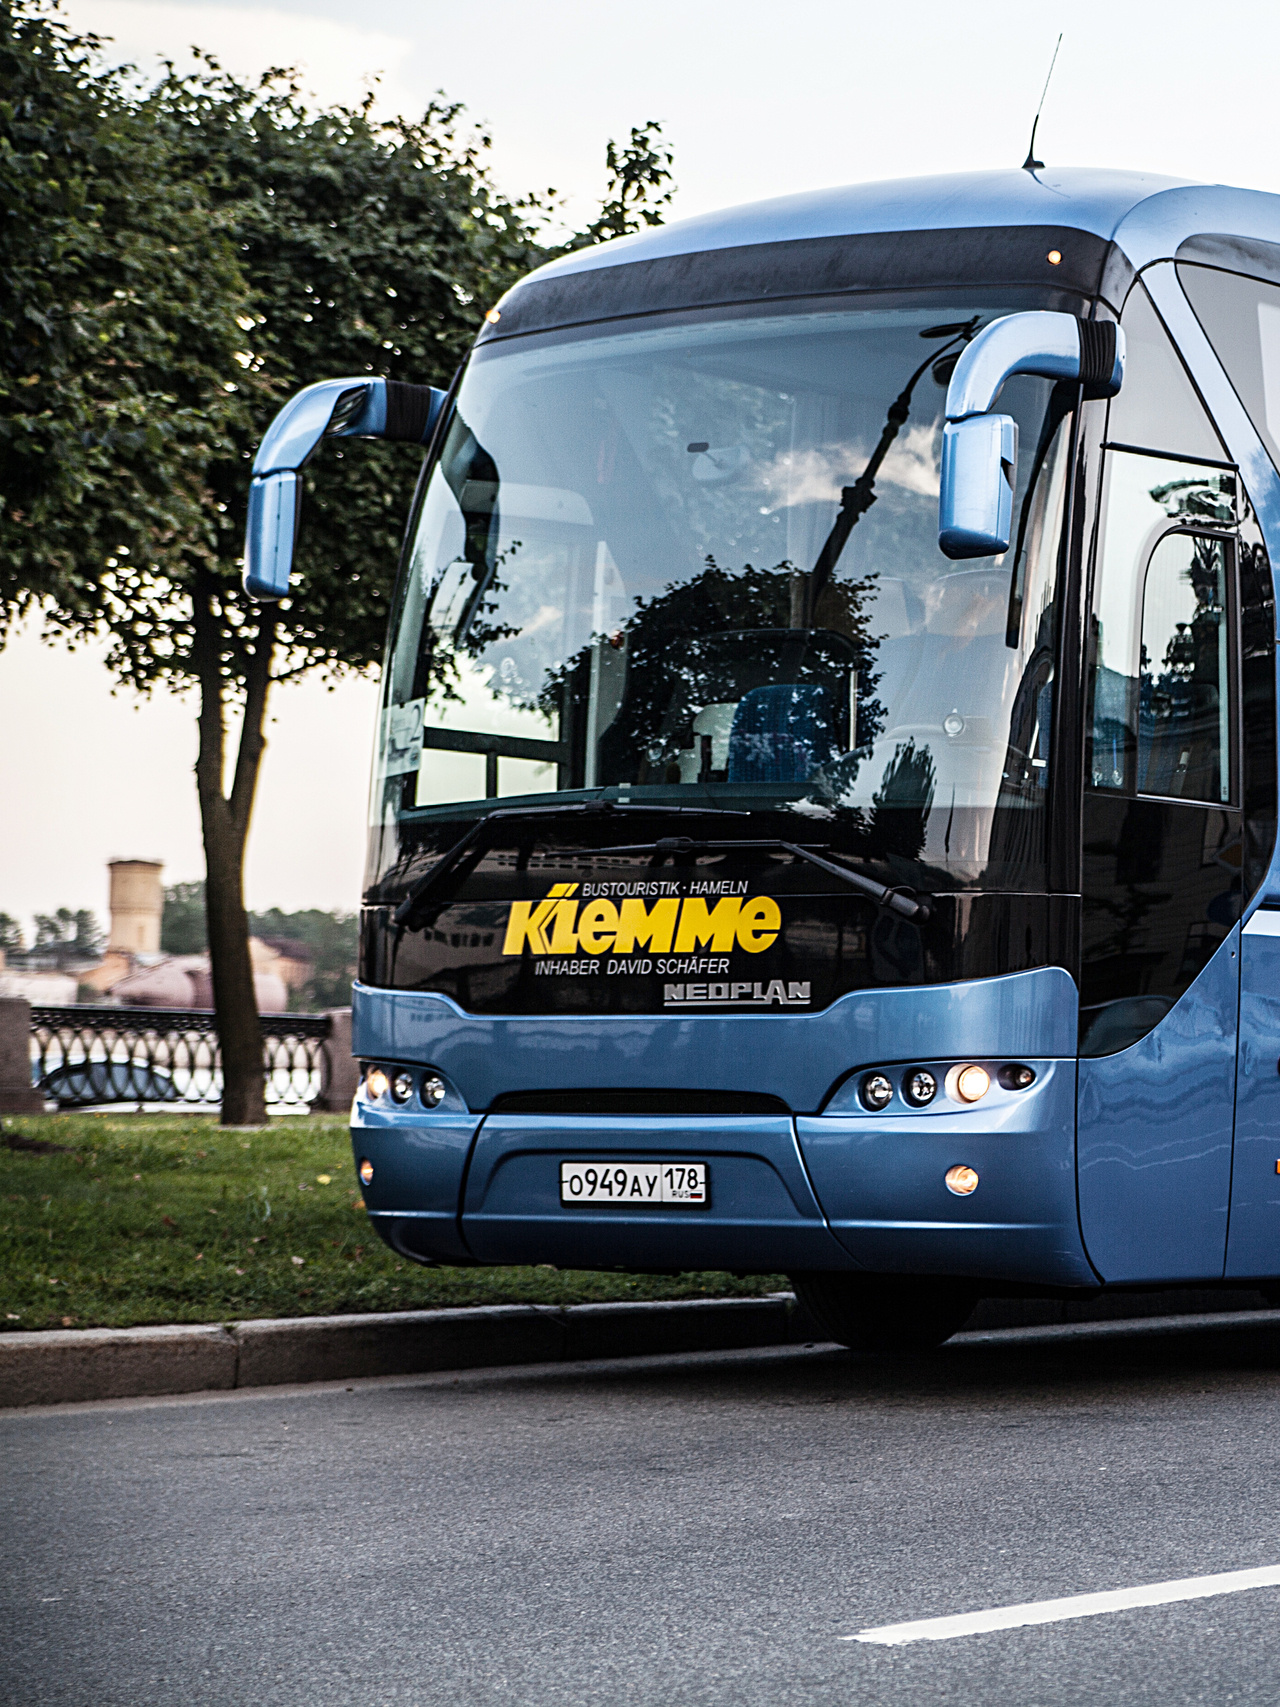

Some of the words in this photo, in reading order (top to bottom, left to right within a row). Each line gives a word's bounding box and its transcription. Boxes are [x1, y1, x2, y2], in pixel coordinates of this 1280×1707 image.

[582, 881, 679, 897] BUSTOURISTIK
[689, 880, 748, 895] HAMELN
[535, 959, 600, 976] INHABER
[606, 959, 652, 975] DAVID
[655, 957, 730, 975] SCHÄFER
[663, 980, 811, 1006] NEOPLAN
[664, 1168, 698, 1190] 178
[672, 1190, 690, 1199] RUS
